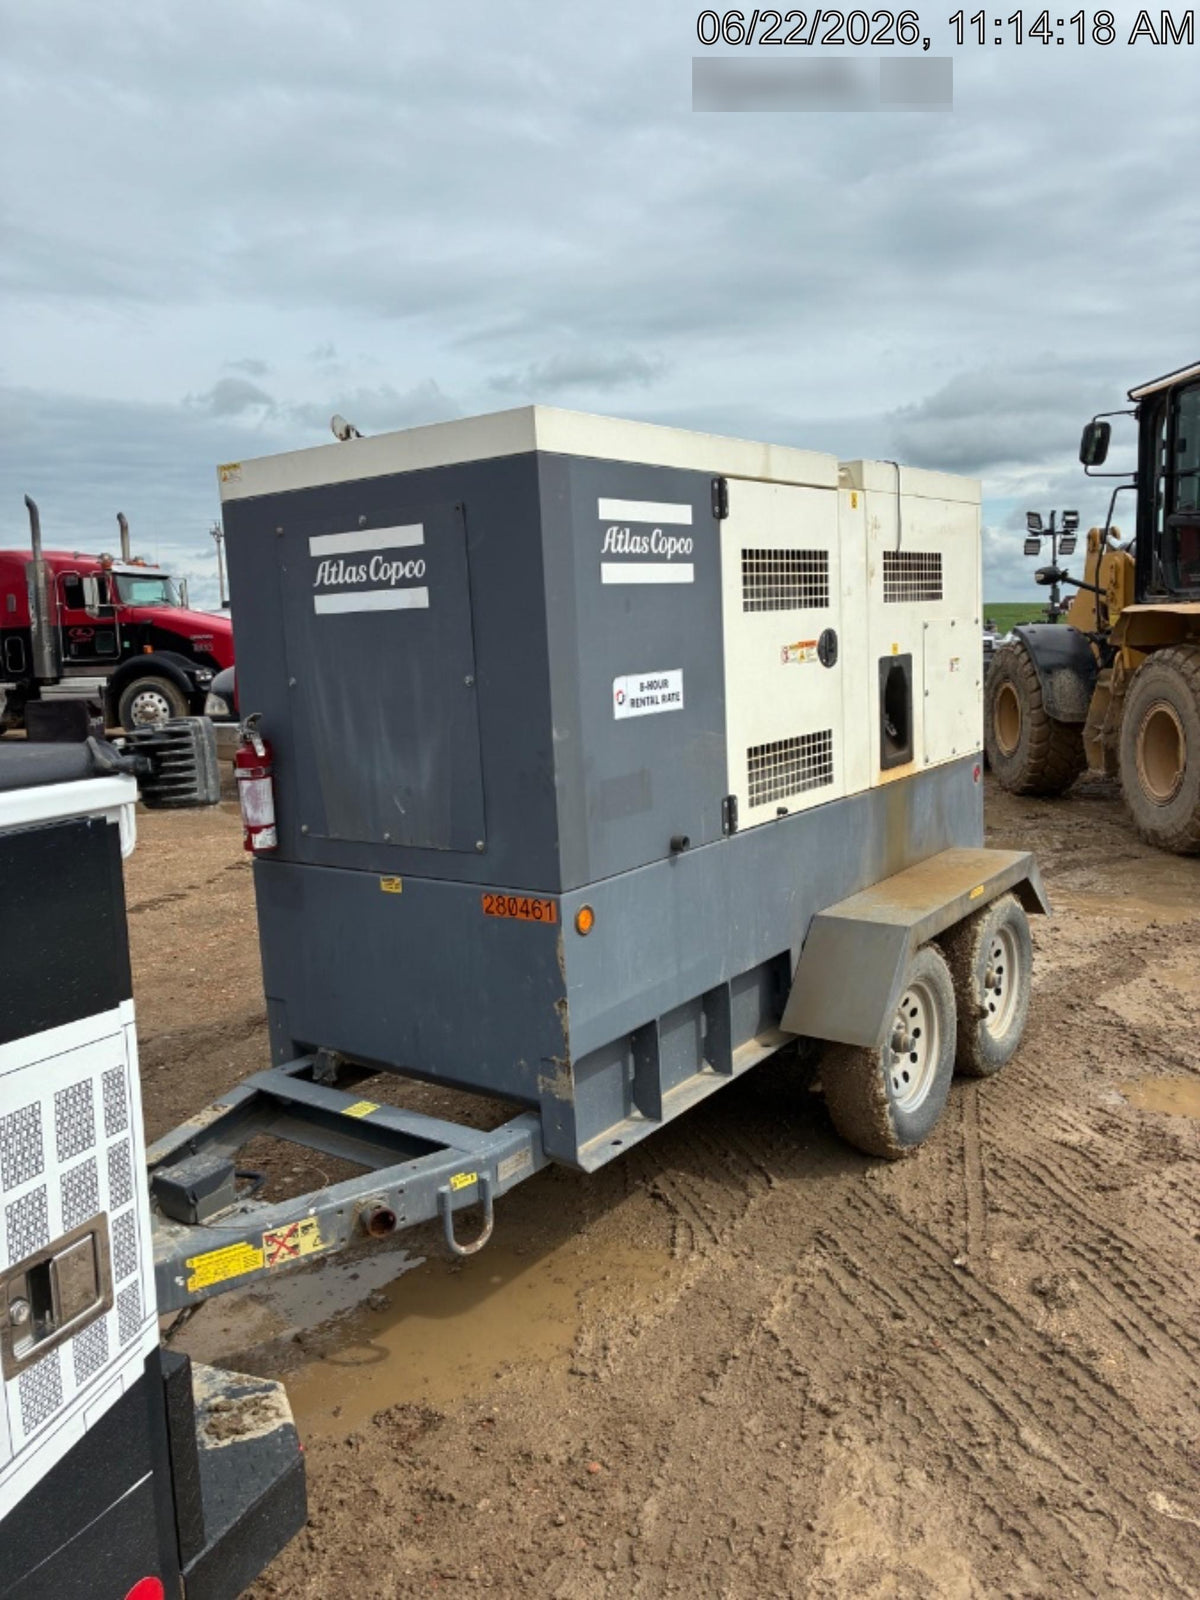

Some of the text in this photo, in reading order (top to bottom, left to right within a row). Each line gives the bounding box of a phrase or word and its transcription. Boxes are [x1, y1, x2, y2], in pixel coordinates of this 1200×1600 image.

[601, 526, 694, 560] Atlas Copco
[313, 555, 426, 588] Atlas Copco
[639, 679, 669, 692] 8-HOUR
[630, 691, 681, 708] RENTAL RATE
[483, 895, 553, 921] 280461
